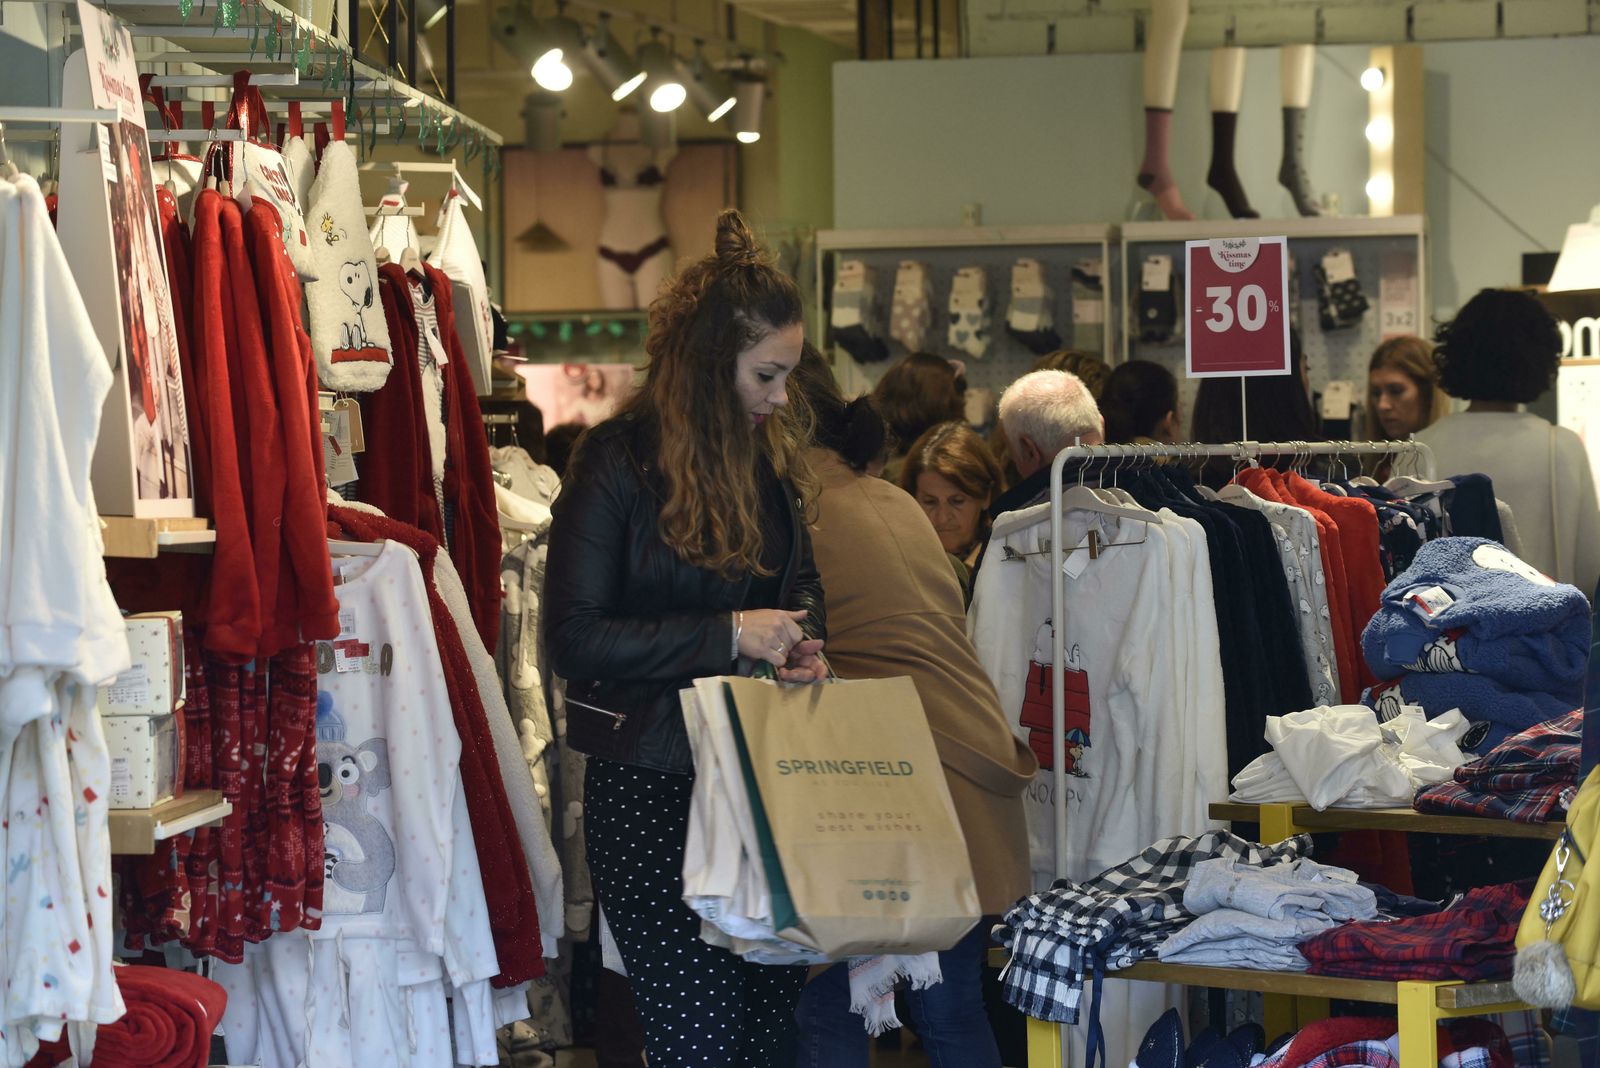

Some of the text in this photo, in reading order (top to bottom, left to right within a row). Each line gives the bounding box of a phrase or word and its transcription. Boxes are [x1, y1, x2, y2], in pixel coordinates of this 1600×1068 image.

[1218, 251, 1252, 261] Kissmas
[1228, 260, 1246, 269] time
[776, 759, 914, 776] SPRINGFIELD
